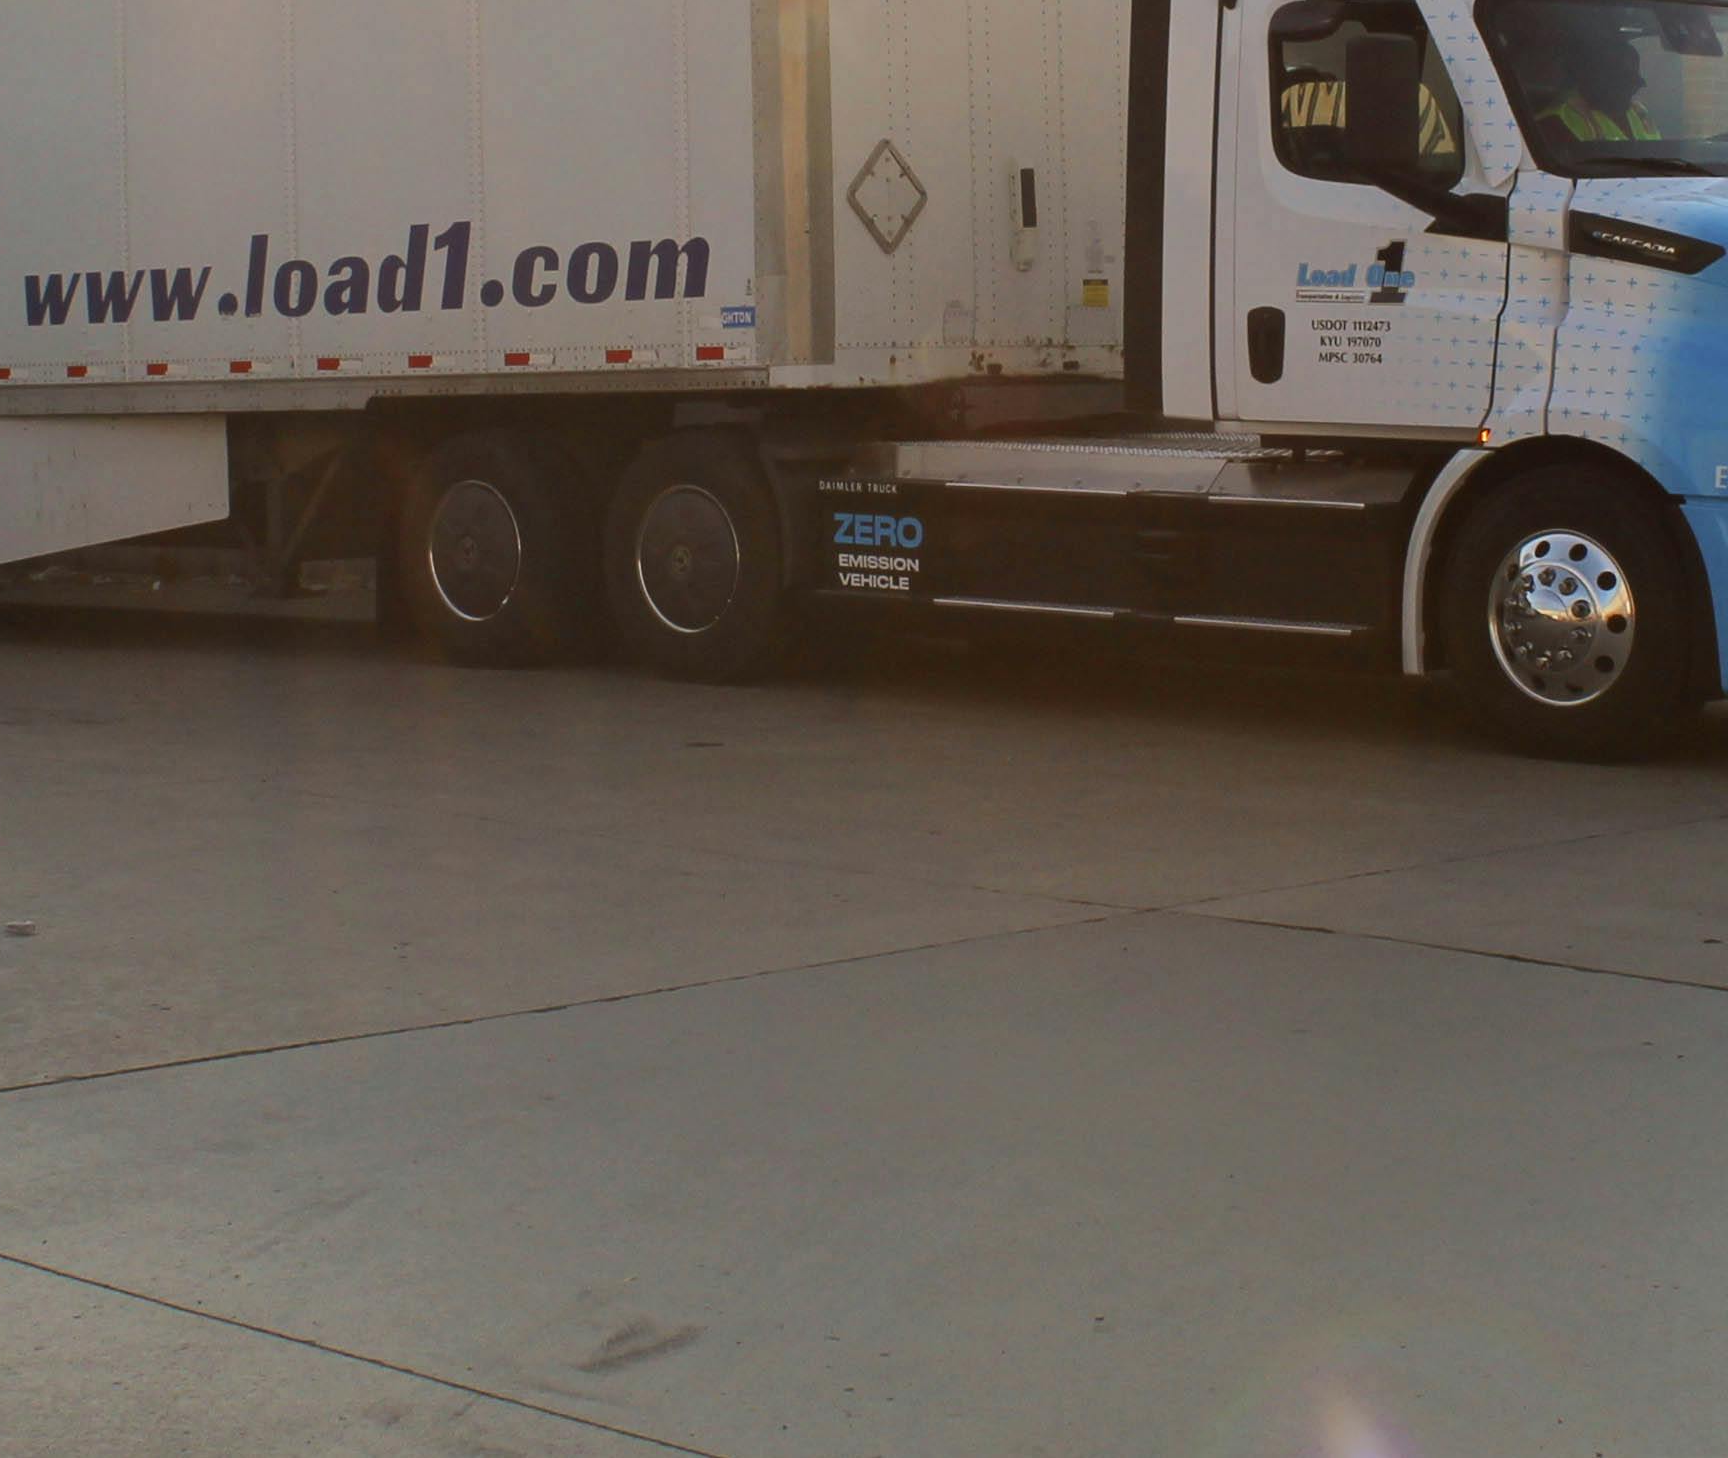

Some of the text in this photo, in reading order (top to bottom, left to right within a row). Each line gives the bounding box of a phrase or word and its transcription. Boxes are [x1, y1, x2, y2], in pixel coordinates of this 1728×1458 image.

[24, 221, 711, 327] www.load1.com
[1297, 262, 1415, 288] Load One
[1312, 320, 1347, 331] USDOT
[1320, 336, 1342, 347] KYU
[1318, 353, 1382, 364] MPSC 30764
[819, 480, 897, 494] DAIMLER TRUCK
[833, 512, 923, 549] ZERO
[838, 553, 920, 572] EMISSION
[839, 572, 910, 591] VEHICLE
